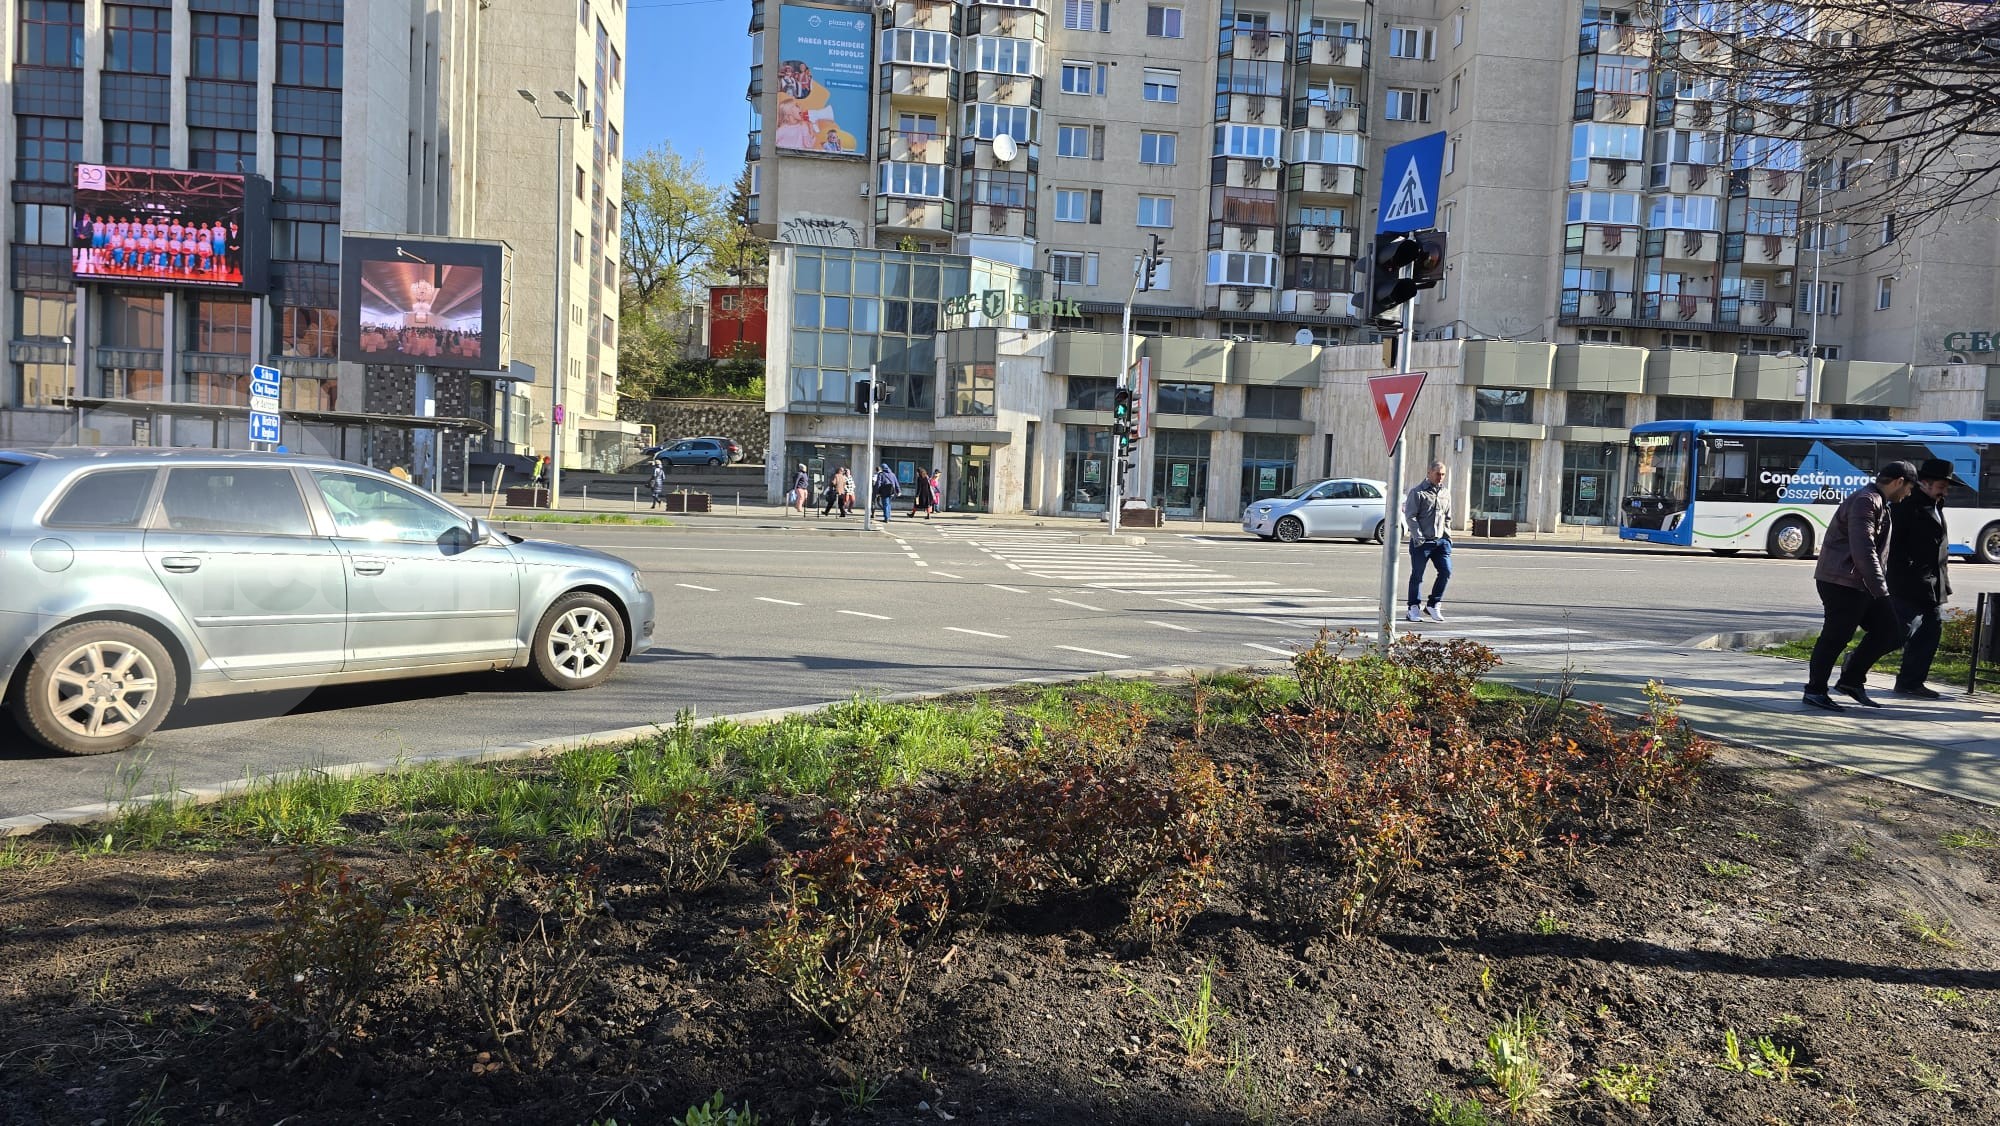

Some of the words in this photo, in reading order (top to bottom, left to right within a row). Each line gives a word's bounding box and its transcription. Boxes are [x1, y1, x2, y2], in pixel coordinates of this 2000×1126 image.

[824, 40, 864, 49] DESCHIDERE
[944, 293, 977, 315] CEC
[1012, 293, 1082, 318] Bank
[1648, 436, 1670, 446] TUDOR
[1760, 471, 1840, 485] Conectăm
[1776, 484, 1857, 504] Összekötjü
